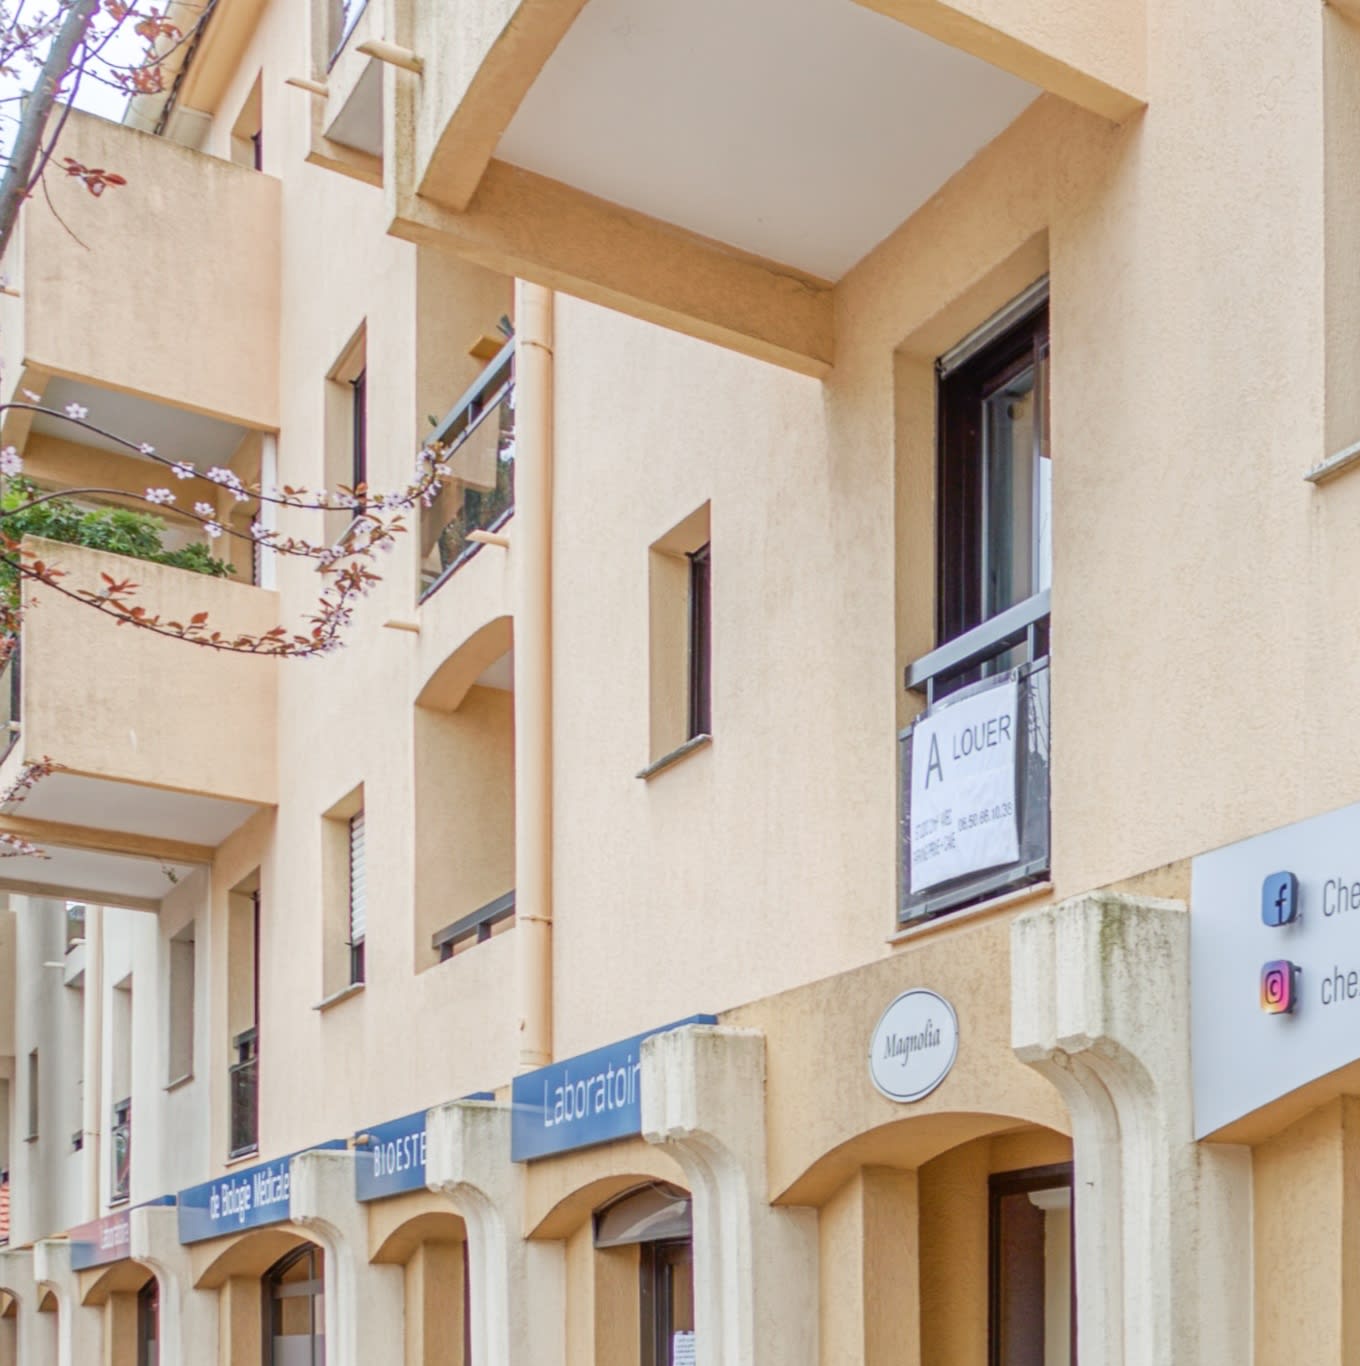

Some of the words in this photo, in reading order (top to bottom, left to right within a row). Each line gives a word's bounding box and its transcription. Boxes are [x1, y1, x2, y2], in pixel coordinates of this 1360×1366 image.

[924, 731, 944, 790] A
[952, 713, 1012, 761] LOUER
[882, 1018, 942, 1067] Magnolia
[210, 1185, 220, 1220] de
[222, 1180, 251, 1223] Biologie
[253, 1164, 290, 1208] Médicale
